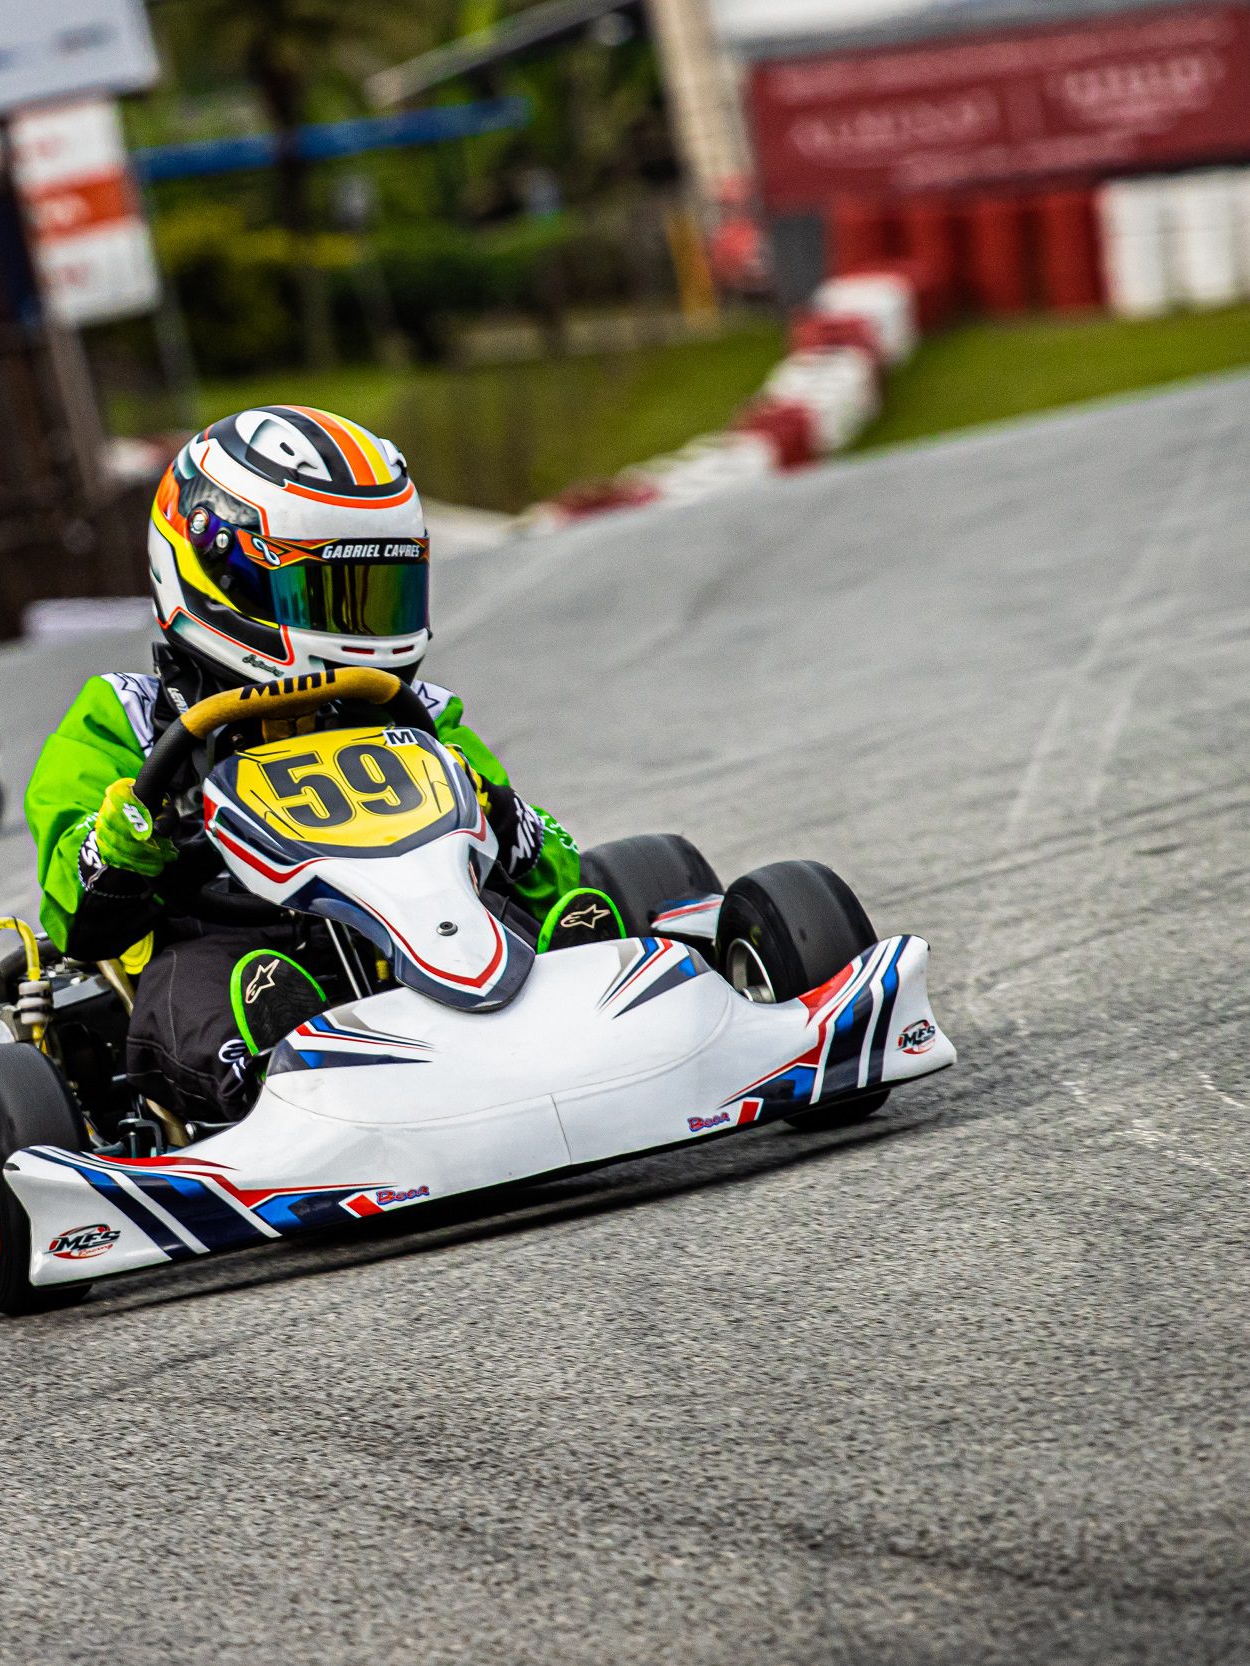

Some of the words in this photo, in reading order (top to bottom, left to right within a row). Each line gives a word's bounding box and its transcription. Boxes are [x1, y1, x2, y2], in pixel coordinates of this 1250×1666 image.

[322, 544, 380, 559] GABRIEL
[384, 543, 421, 558] CAYRES
[387, 731, 414, 745] M
[257, 743, 426, 829] 59
[896, 1025, 936, 1051] MFS
[43, 1230, 121, 1255] MFS
